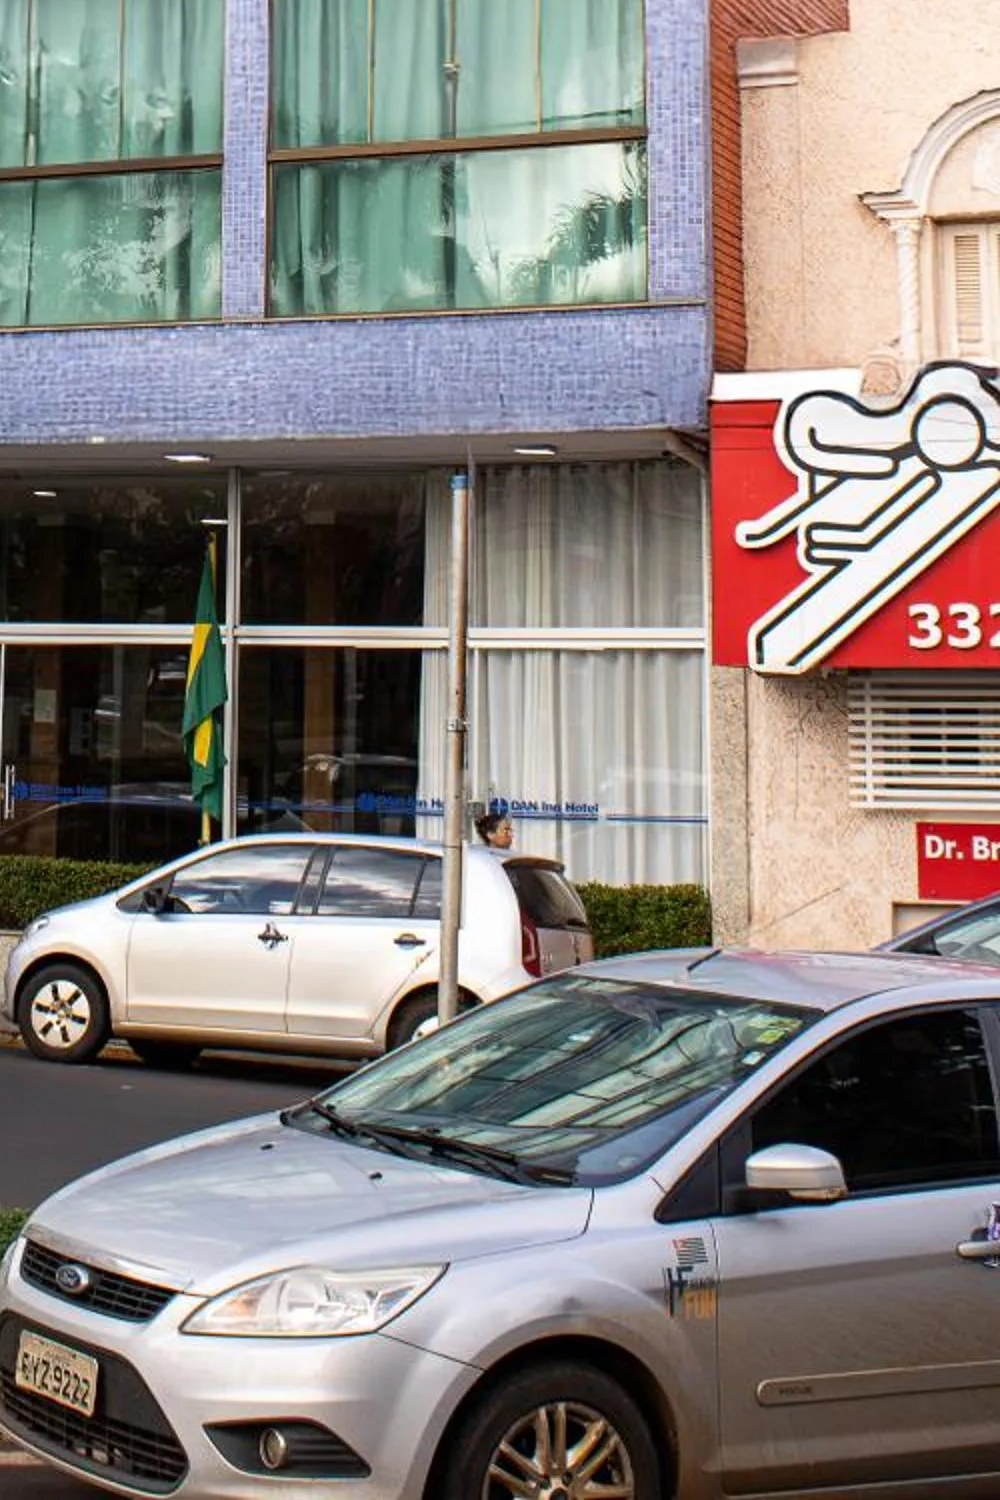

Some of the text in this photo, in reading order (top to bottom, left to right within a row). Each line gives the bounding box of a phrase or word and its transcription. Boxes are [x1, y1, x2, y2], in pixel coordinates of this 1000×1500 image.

[511, 800, 600, 813] DAN Inn Hotel
[925, 834, 964, 860] Dr.
